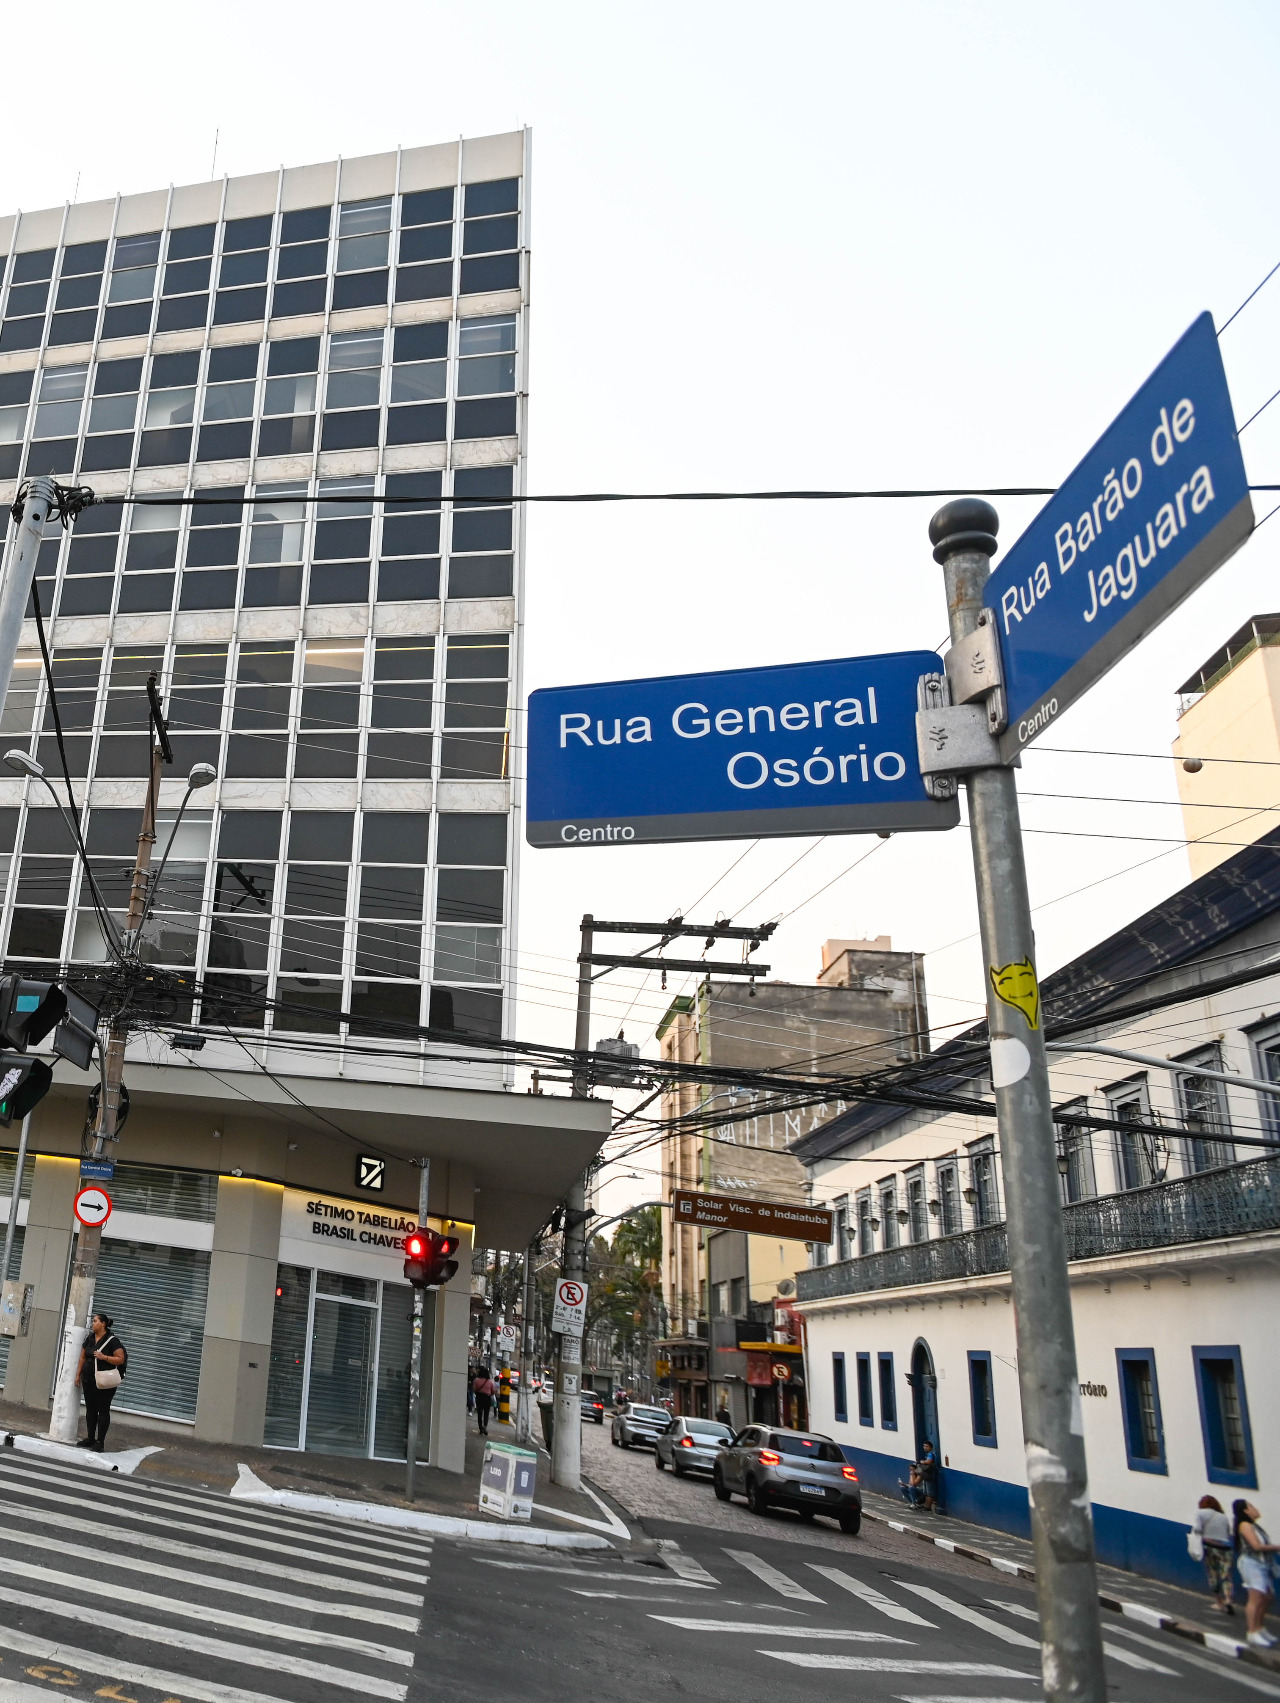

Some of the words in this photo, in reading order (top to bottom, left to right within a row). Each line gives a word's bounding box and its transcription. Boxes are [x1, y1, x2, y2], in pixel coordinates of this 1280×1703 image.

[1000, 561, 1052, 636] Rua
[1054, 456, 1143, 575] Barão
[1150, 397, 1196, 466] de
[1082, 464, 1215, 623] Jaguara
[559, 712, 652, 748] Rua
[671, 686, 878, 740] General
[1017, 697, 1058, 743] Centro
[726, 743, 907, 790] Osório
[560, 822, 635, 843] Centro
[306, 1200, 355, 1221] SÉTIMO
[357, 1211, 416, 1233] TABELIÃO
[696, 1199, 724, 1210] Solar
[728, 1203, 754, 1214] Visc.
[758, 1207, 771, 1217] de
[774, 1209, 829, 1225] Indaiatuba
[696, 1211, 729, 1223] Manor
[312, 1221, 357, 1241] BRASIL
[359, 1231, 407, 1251] CHAVES
[489, 1466, 502, 1477] LIXO
